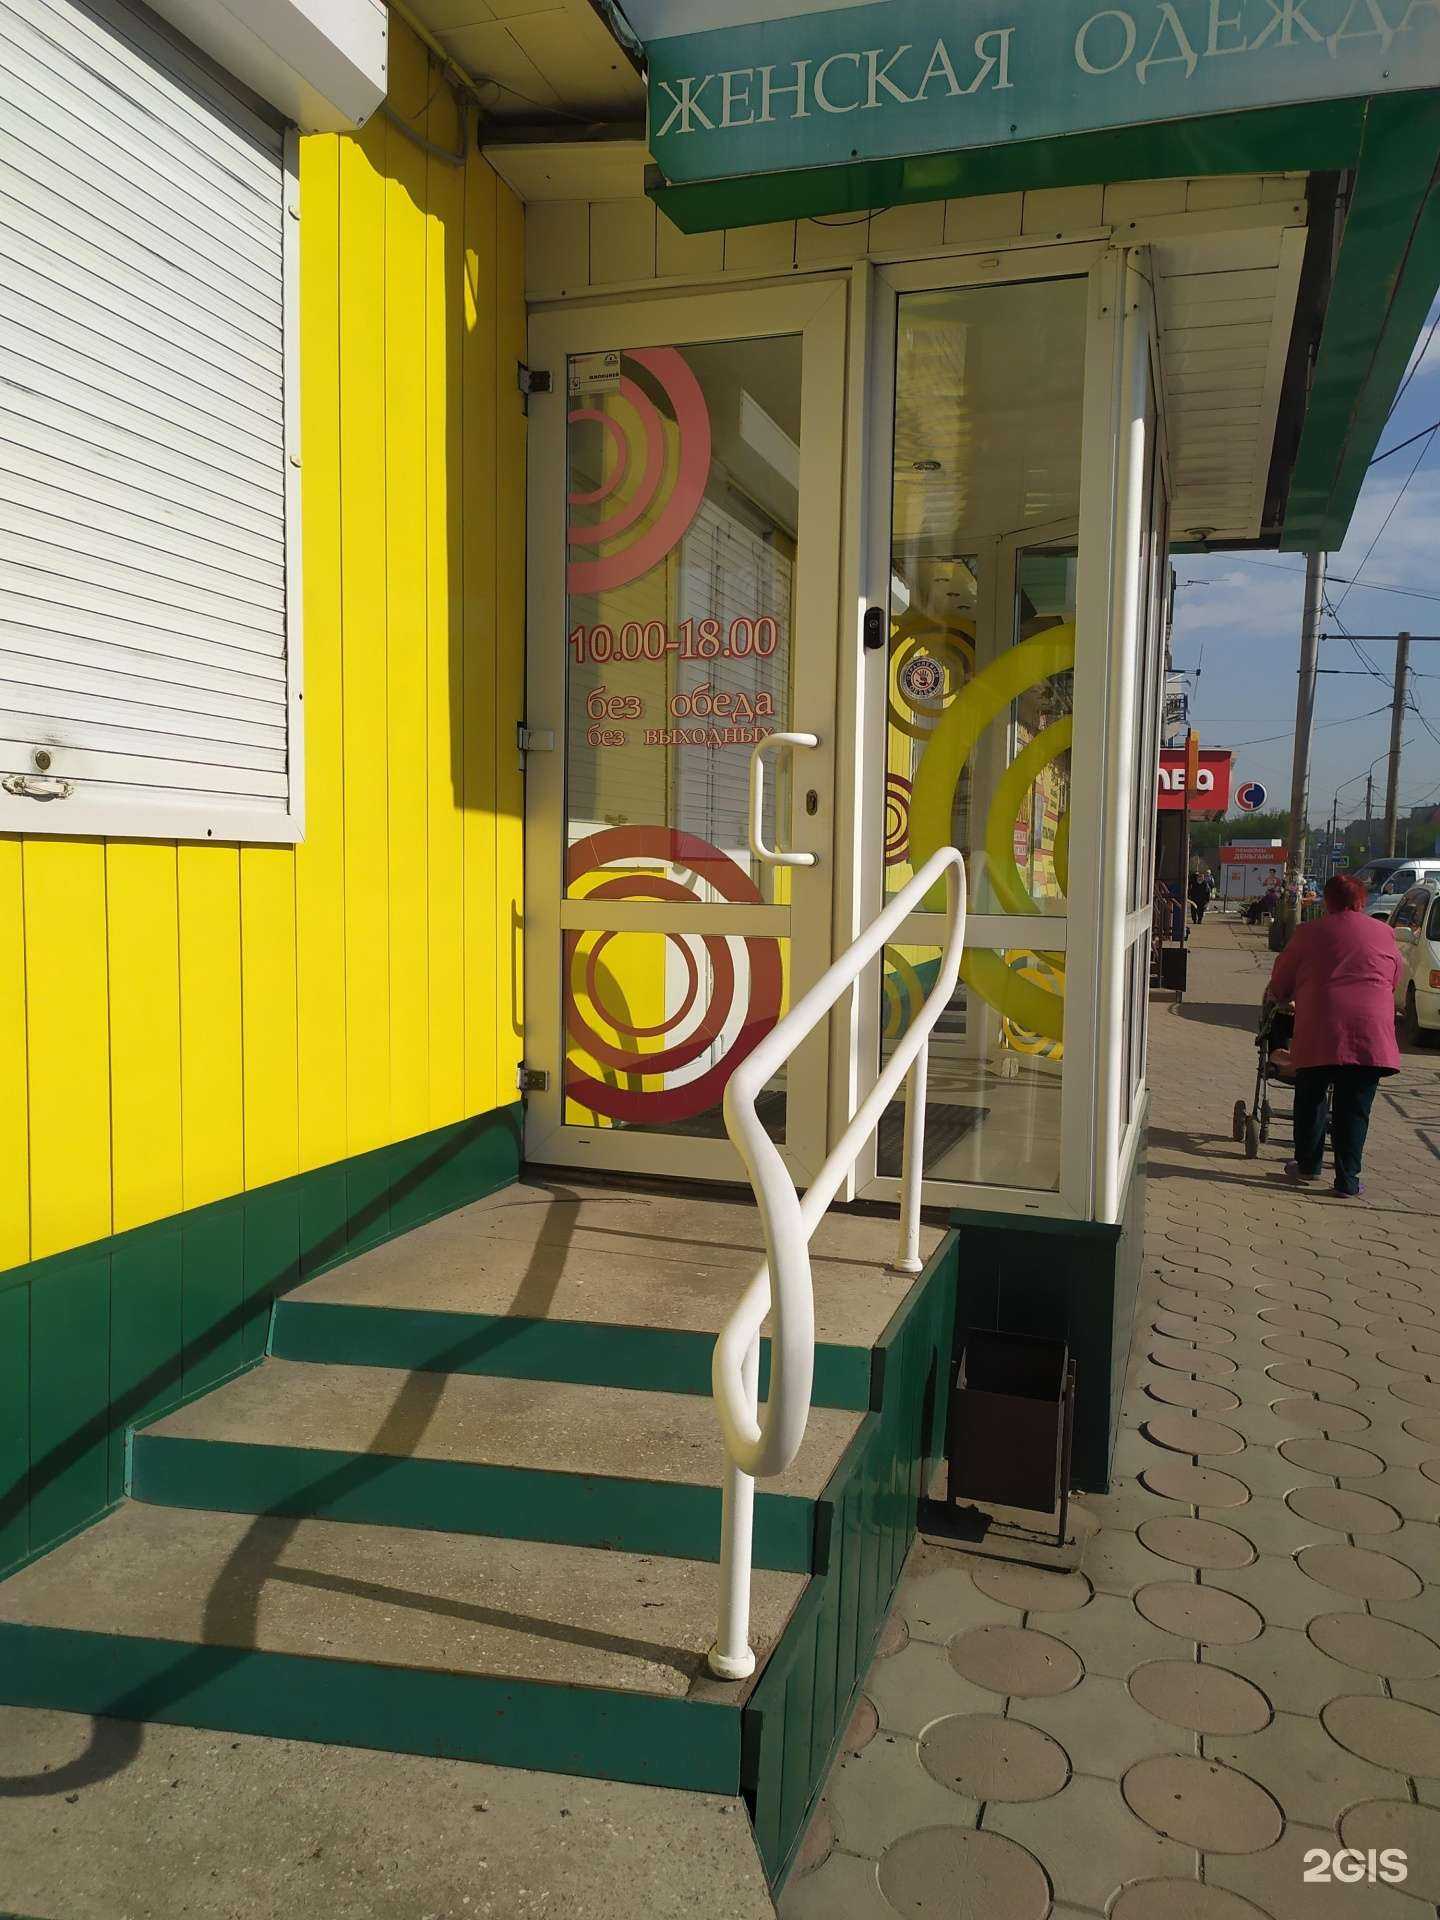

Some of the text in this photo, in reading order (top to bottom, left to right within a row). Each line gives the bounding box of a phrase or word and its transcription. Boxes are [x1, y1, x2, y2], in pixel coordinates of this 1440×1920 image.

[655, 28, 1015, 137] ЖЕНСКАЯ
[569, 616, 778, 664] 10.00-18.00
[586, 682, 775, 724] без обеда
[587, 724, 626, 746] без
